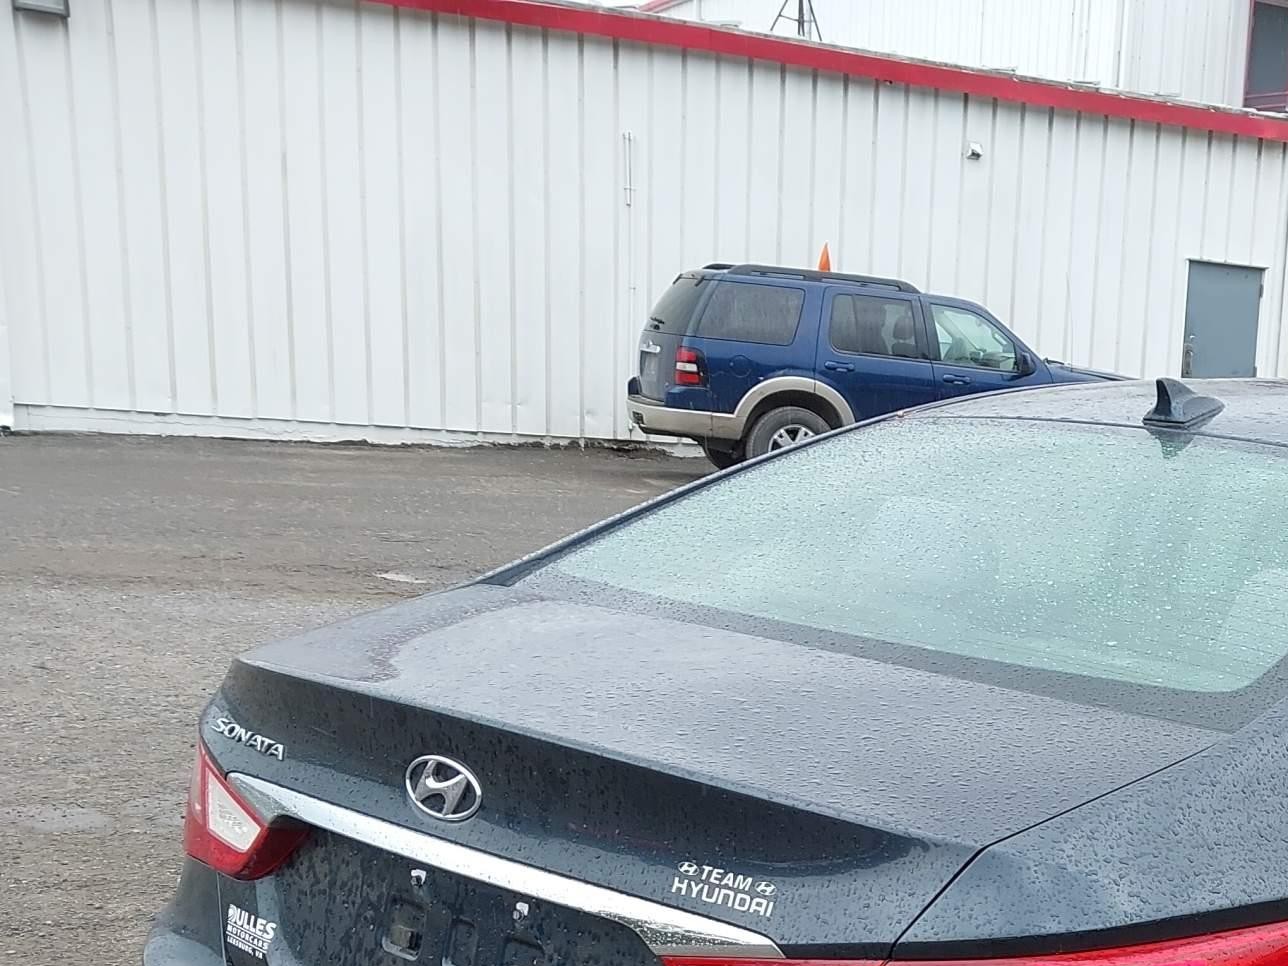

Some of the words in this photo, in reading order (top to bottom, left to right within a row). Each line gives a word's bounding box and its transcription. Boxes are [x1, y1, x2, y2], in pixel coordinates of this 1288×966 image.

[209, 717, 285, 761] SONATA
[701, 865, 753, 891] TEAM
[671, 876, 774, 918] HYUNDAI
[226, 924, 270, 950] MOTORCARS
[255, 950, 263, 960] VA
